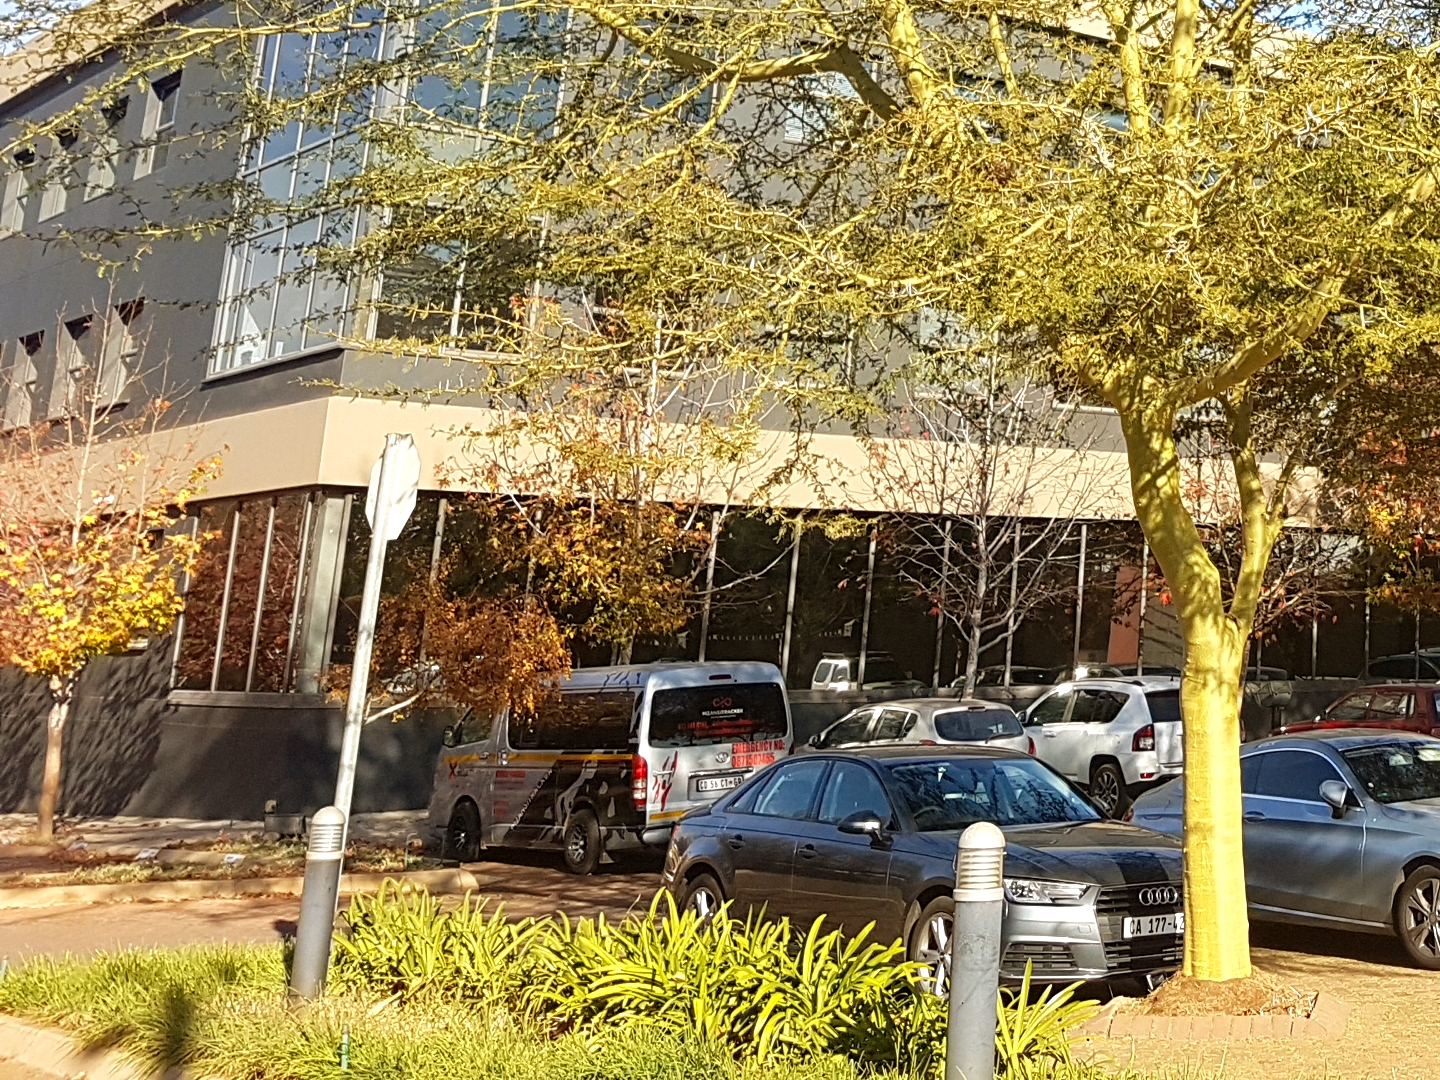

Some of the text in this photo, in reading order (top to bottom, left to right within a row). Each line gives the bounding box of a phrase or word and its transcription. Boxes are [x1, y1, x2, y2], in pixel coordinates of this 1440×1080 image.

[731, 740, 773, 754] EMERGENCY
[1129, 916, 1185, 935] CA 177-42
